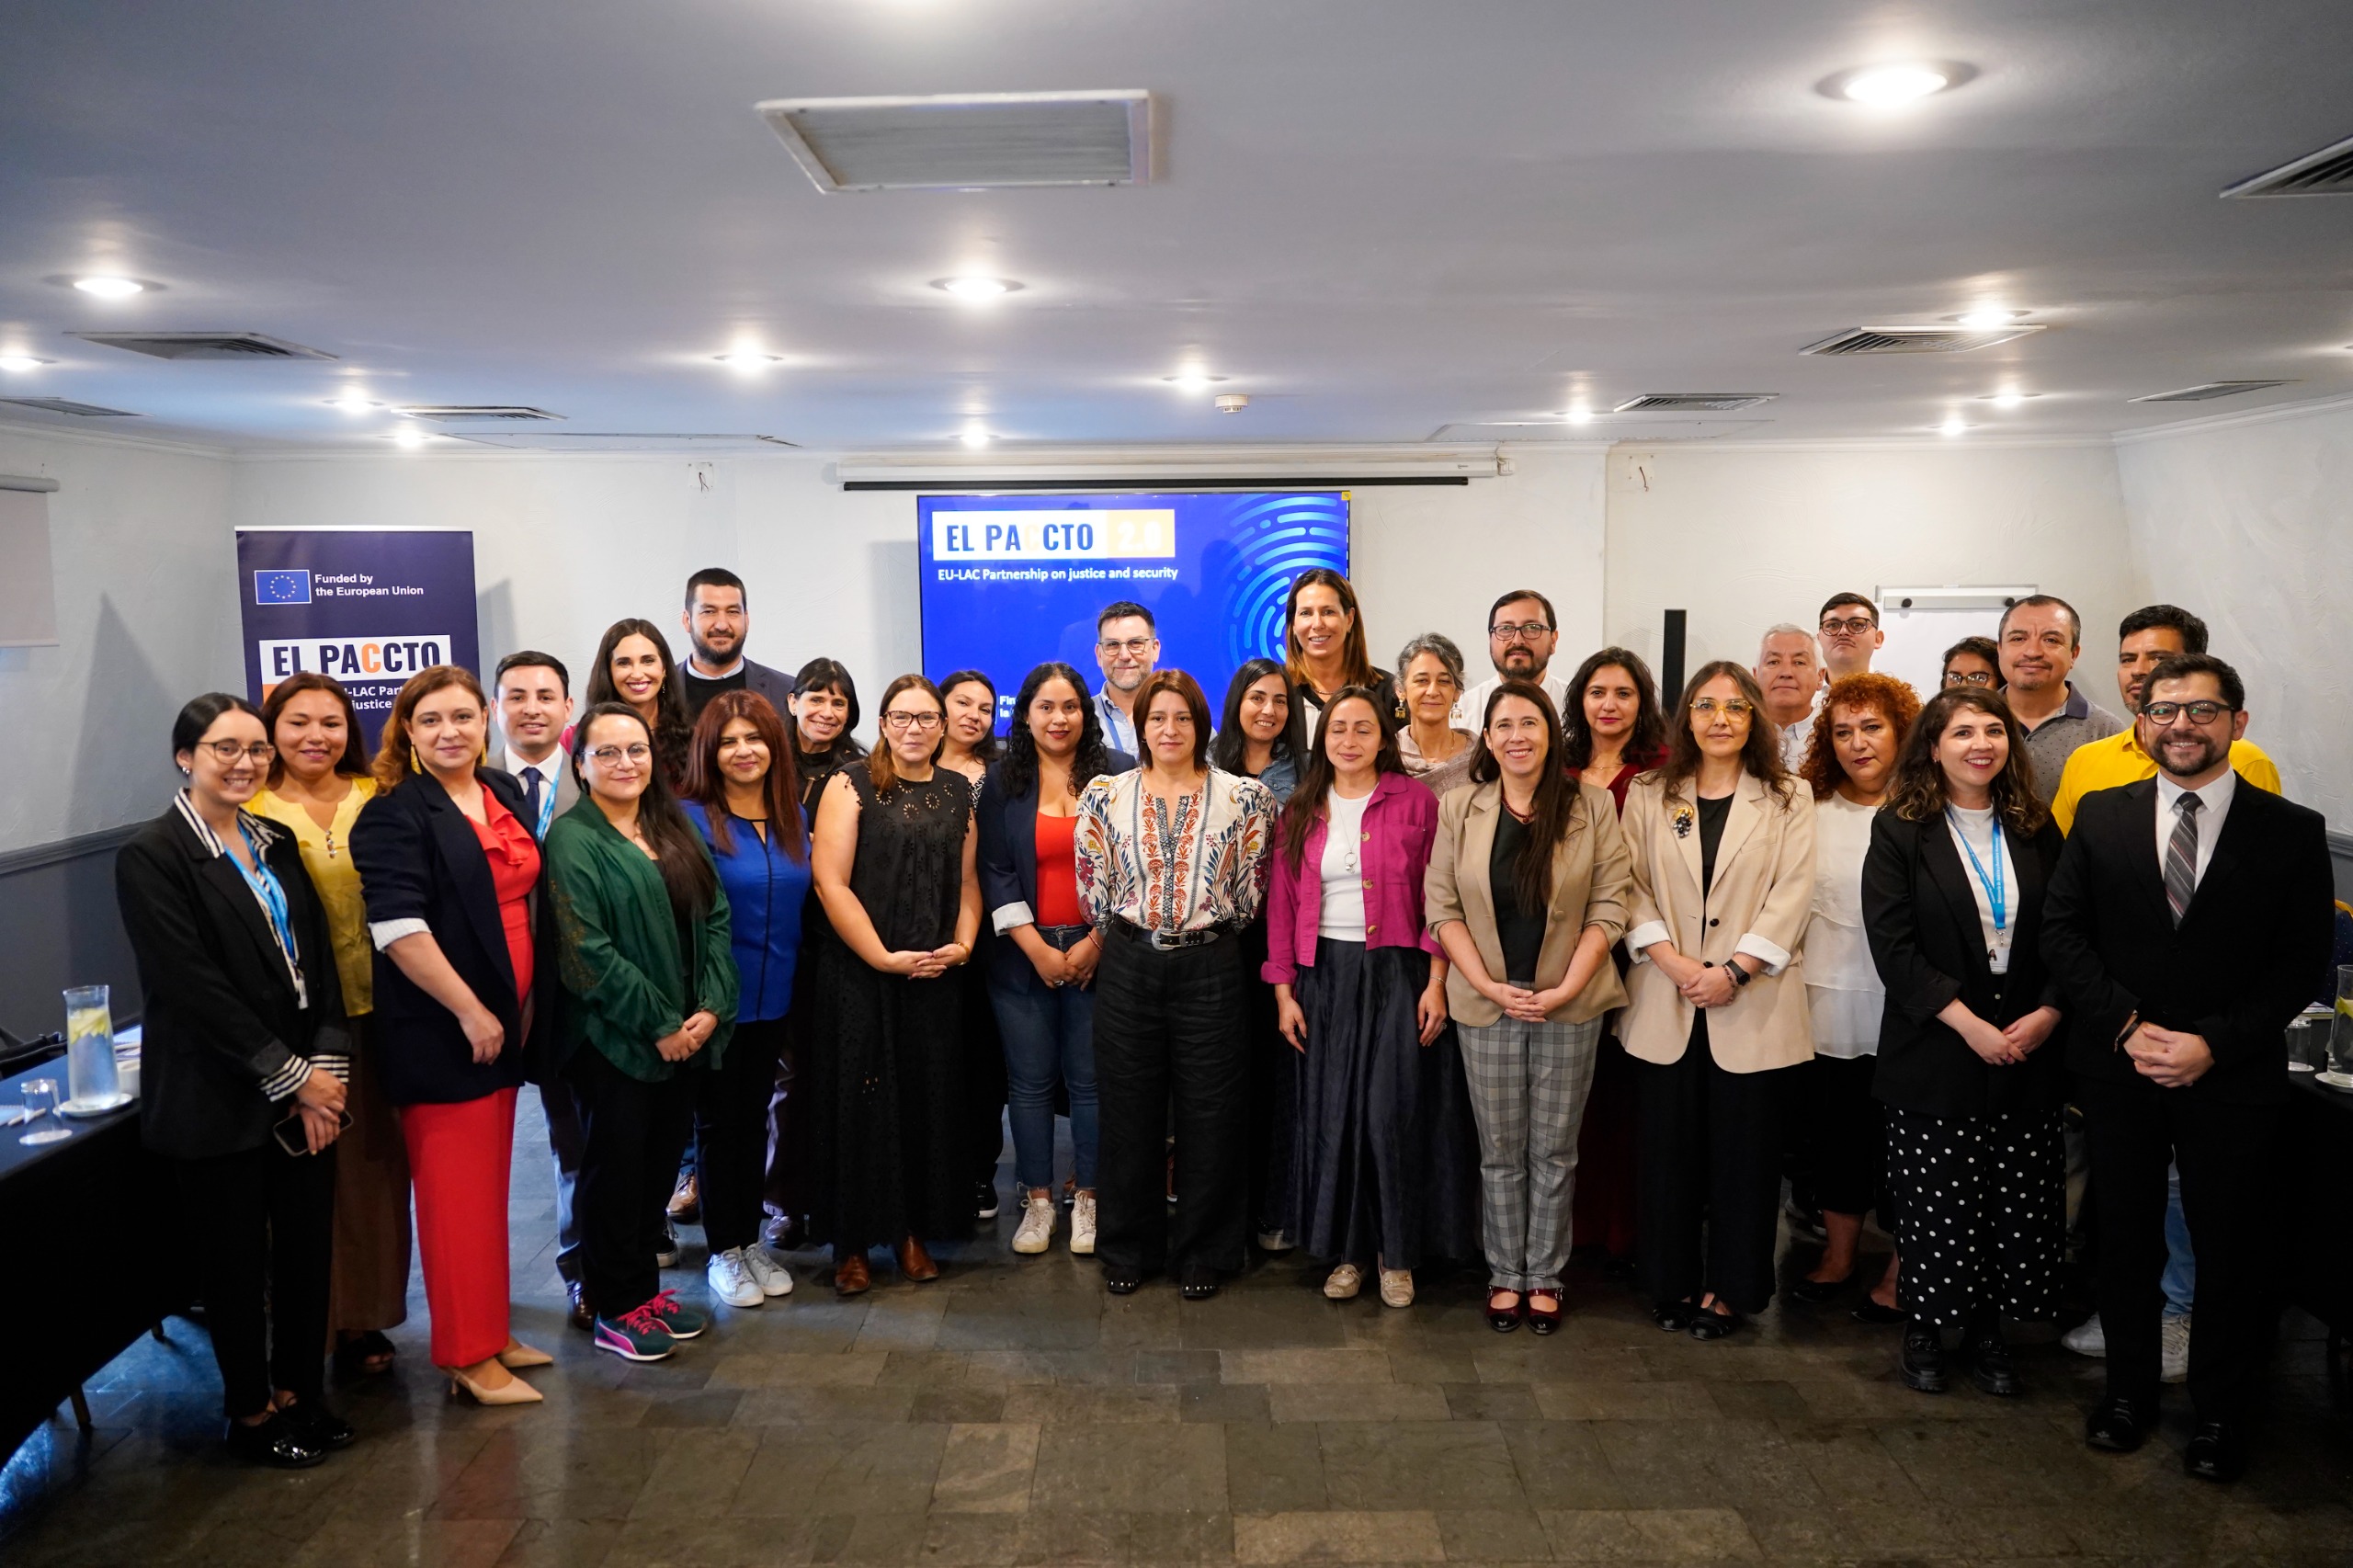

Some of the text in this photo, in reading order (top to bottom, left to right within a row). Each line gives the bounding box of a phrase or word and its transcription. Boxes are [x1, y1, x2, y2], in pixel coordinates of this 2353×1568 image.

[947, 521, 1162, 551] EL PACCTO 2.0
[314, 574, 373, 585] Funded by
[938, 566, 1178, 582] EU-LAC Partnership on justice and security
[315, 585, 424, 597] the European Union
[273, 642, 440, 676] EL PACCTO
[351, 699, 392, 711] justice
